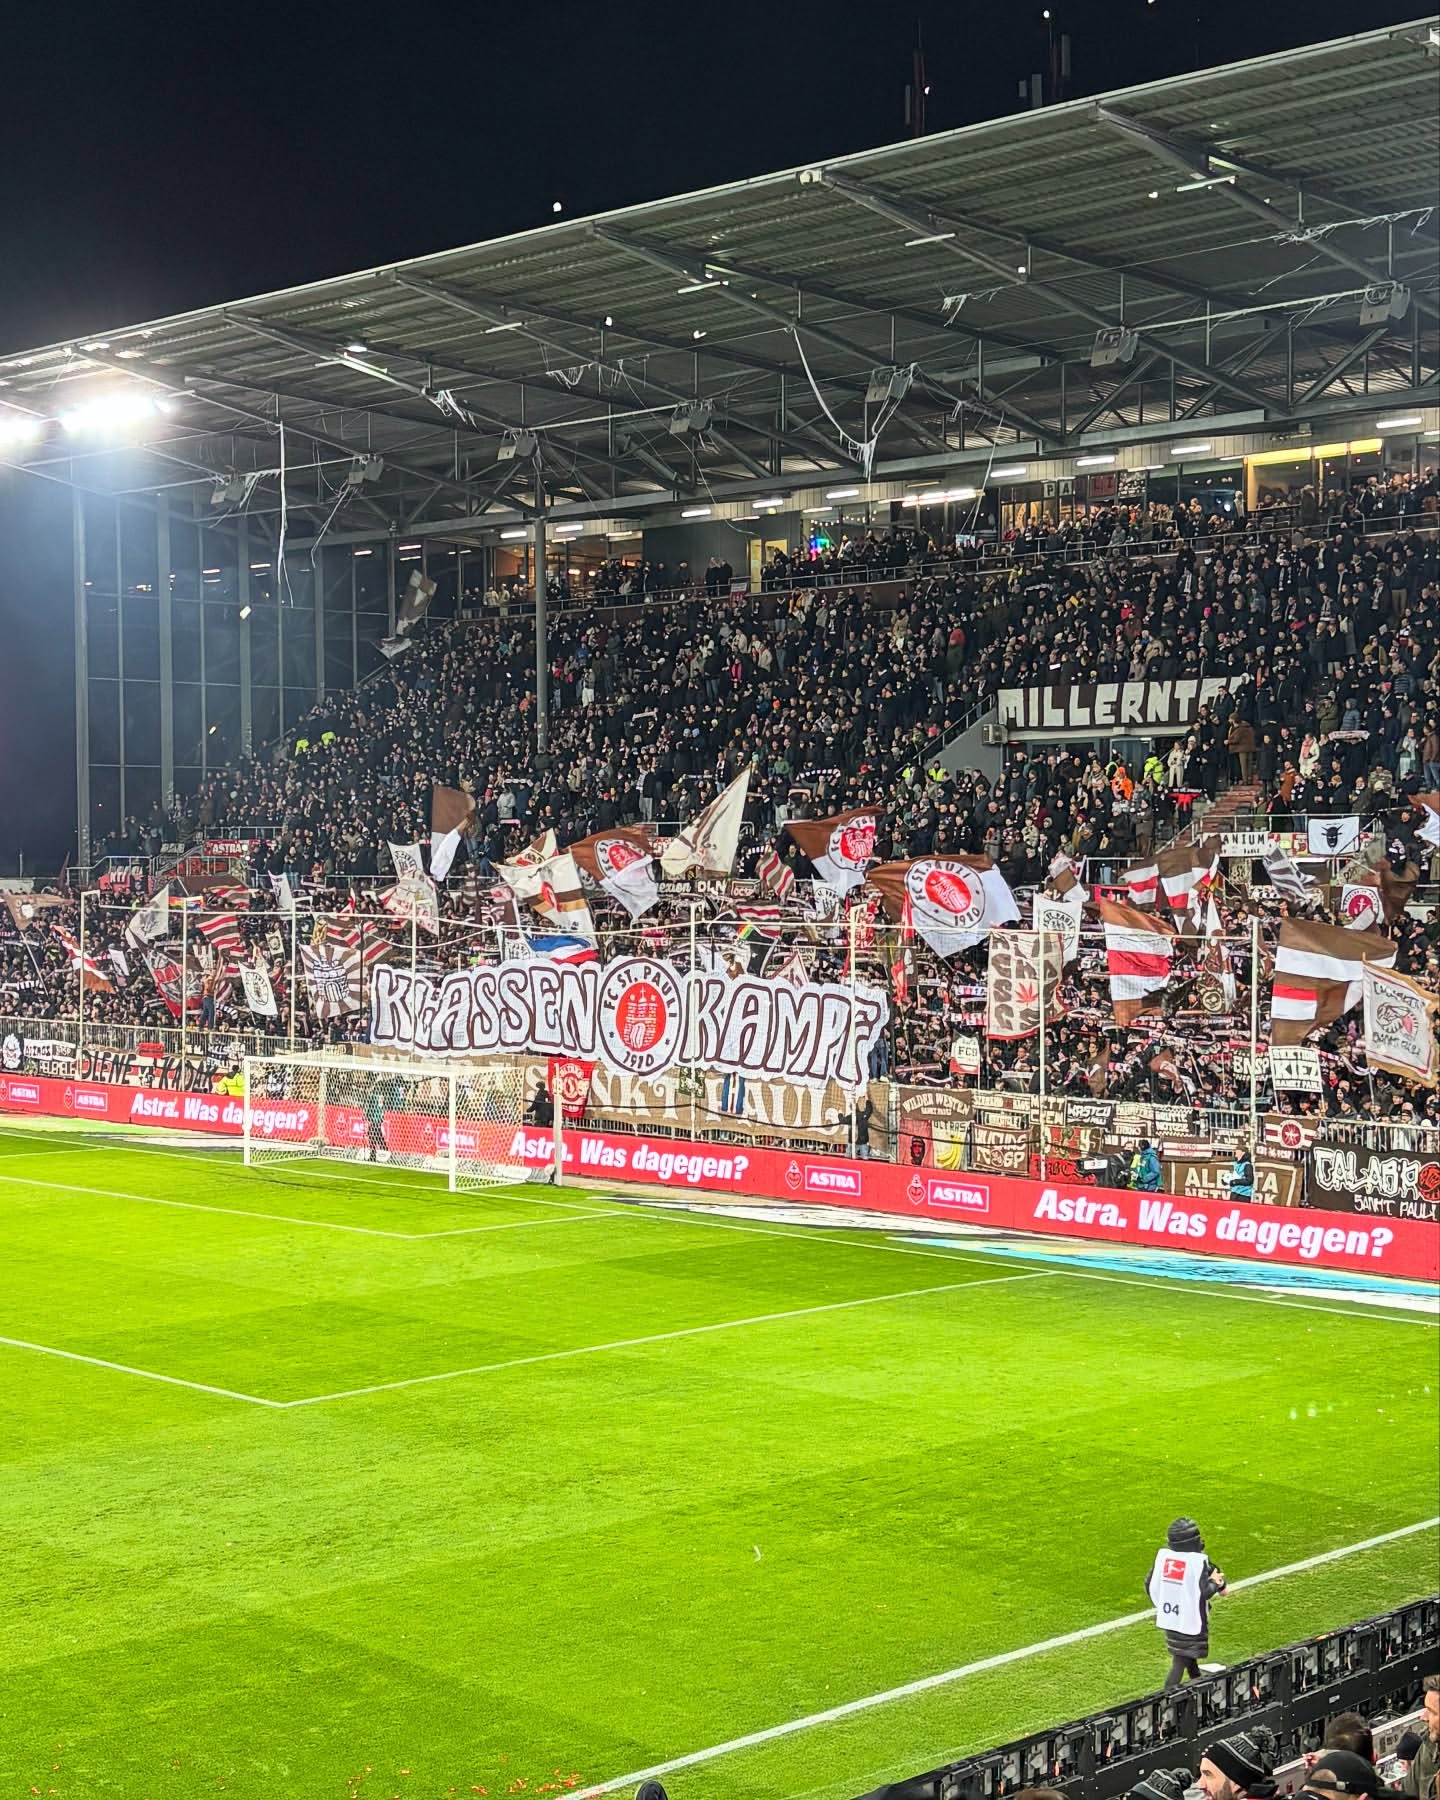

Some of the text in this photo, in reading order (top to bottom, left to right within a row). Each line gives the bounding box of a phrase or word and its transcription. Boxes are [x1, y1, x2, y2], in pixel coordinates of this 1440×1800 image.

[998, 677, 1241, 728] MILLERNT
[213, 844, 241, 854] ASTRA
[1223, 834, 1265, 845] ANIUM
[912, 886, 925, 900] FC
[926, 861, 971, 879] PAULI
[954, 908, 980, 926] 1910
[604, 965, 678, 1018] FC ST. PAULI
[375, 966, 598, 1053] KLASSEN
[679, 979, 881, 1085] KAMPF
[623, 1051, 654, 1069] 1910
[1274, 1061, 1320, 1081] KIEZ
[11, 1087, 37, 1099] ASTRA
[77, 1095, 105, 1107] ASTRA
[525, 1065, 680, 1120] SNKT
[130, 1092, 309, 1133] Astra. Was daegen?
[902, 1093, 934, 1113] WILDER
[936, 1093, 970, 1116] WESTEN
[934, 1120, 966, 1133] ULTRAS
[580, 1138, 627, 1168] Was
[632, 1144, 749, 1182] dagegen?
[809, 1171, 856, 1189] ASTRA
[1185, 1167, 1279, 1193] ALETA
[933, 1186, 984, 1206] ASTRA
[1354, 1194, 1437, 1221] SANKT PAULI
[1034, 1189, 1393, 1260] Astra. Was dagegen?
[1163, 1602, 1180, 1616] 04
